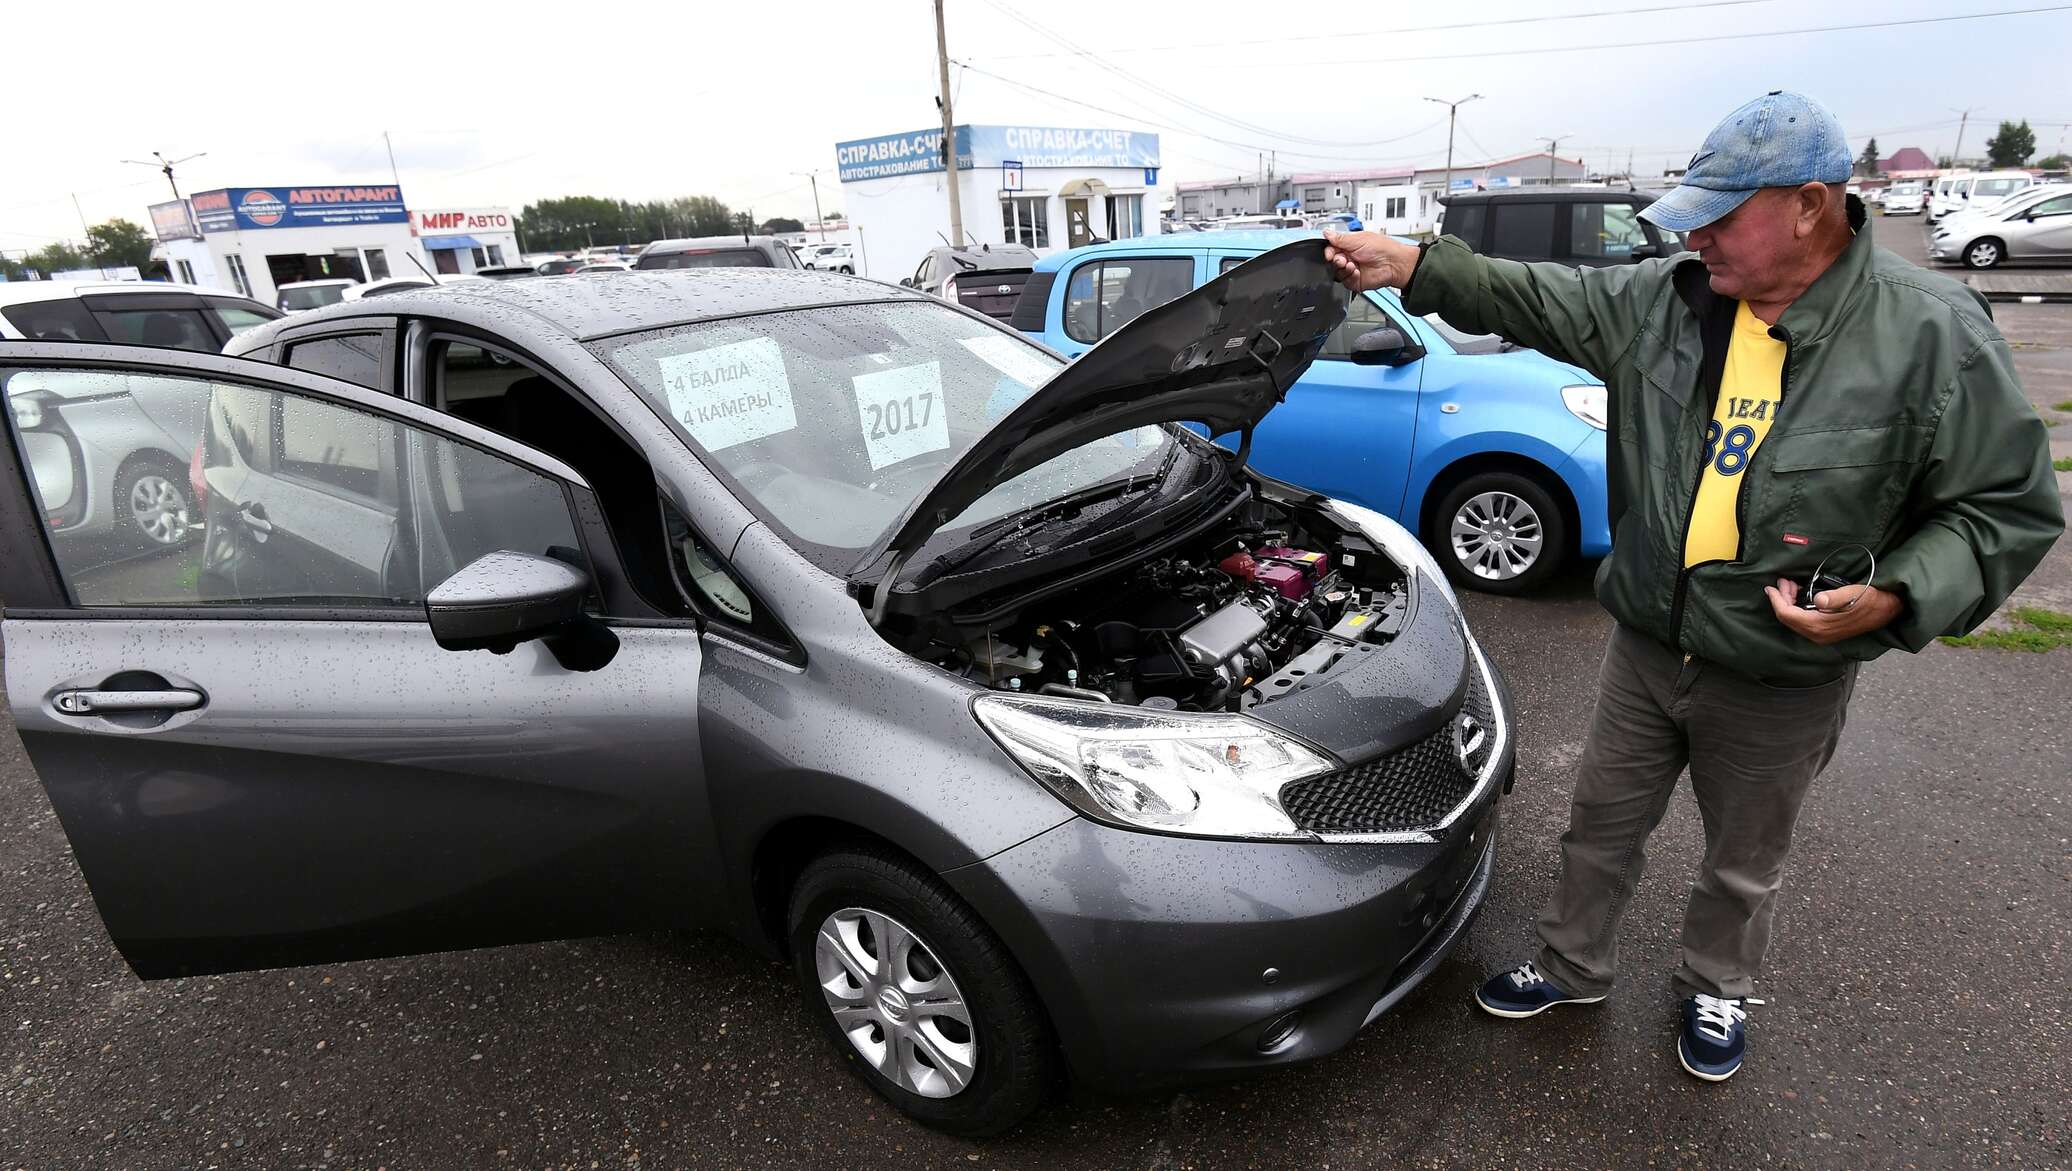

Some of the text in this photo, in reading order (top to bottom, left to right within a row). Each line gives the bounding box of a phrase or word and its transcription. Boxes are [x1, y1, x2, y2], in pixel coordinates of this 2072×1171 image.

[838, 131, 956, 165] СПРАВКА-СЧЕ
[1006, 128, 1132, 151] СПРАВКА-СЧЕТ
[841, 159, 929, 180] АВТОСТРАХОВАНИЕ
[1009, 172, 1015, 186] 1
[289, 187, 399, 204] АВТОГАРАНТ
[422, 212, 465, 229] МИР
[468, 214, 507, 228] АВТО
[674, 376, 685, 391] 4
[684, 391, 772, 424] 4 КАМЕРЫ
[867, 392, 933, 441] 2017
